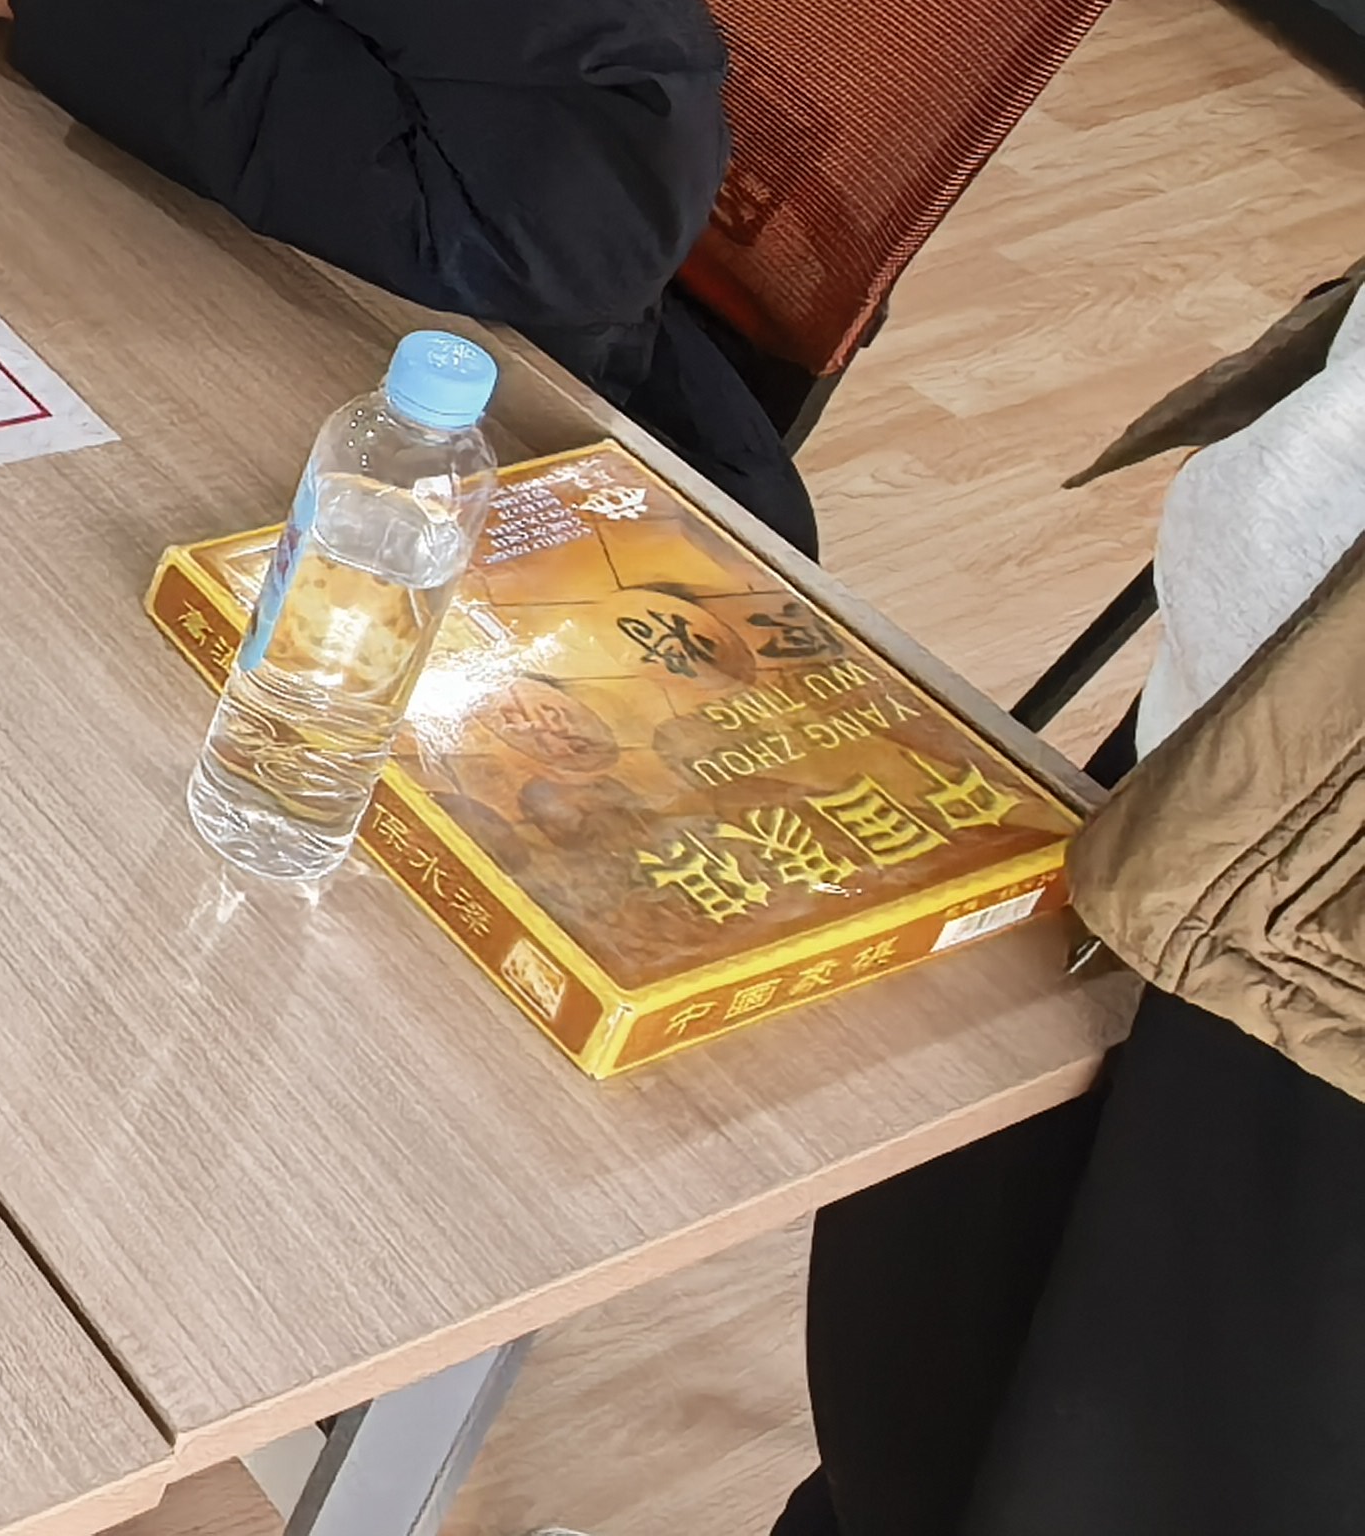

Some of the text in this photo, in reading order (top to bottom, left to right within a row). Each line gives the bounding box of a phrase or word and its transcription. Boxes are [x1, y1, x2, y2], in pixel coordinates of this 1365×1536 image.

[692, 693, 921, 787] YANG ZHOU
[705, 658, 878, 731] WU TING
[636, 748, 1024, 924] 中国象棋
